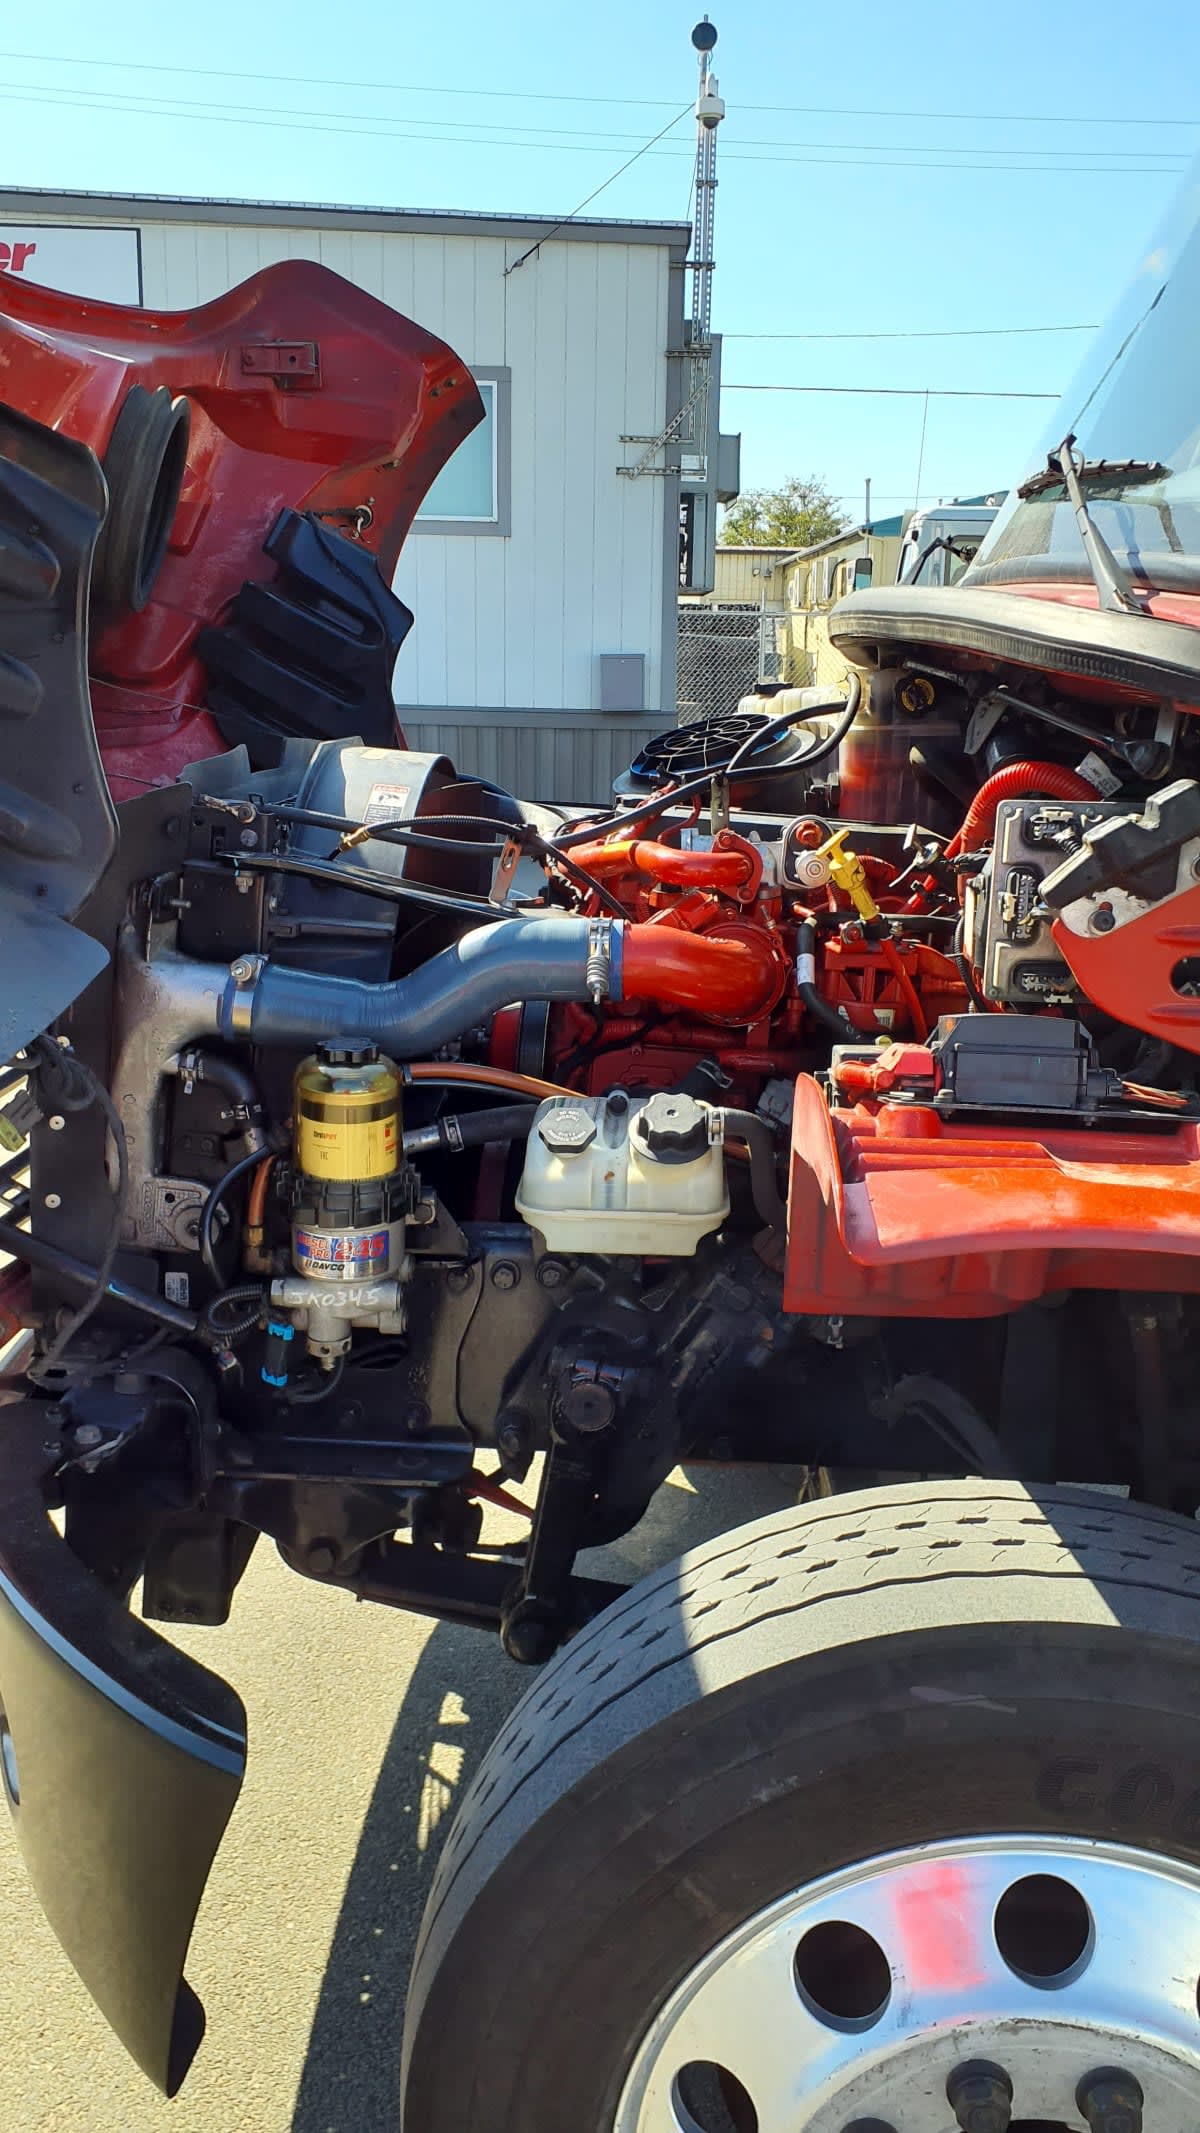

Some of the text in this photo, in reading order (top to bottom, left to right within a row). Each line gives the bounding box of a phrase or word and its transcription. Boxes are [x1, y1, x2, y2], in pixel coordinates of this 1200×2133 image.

[308, 1247, 331, 1260] PRO
[334, 1236, 385, 1262] 245
[312, 1261, 345, 1271] DAVCO
